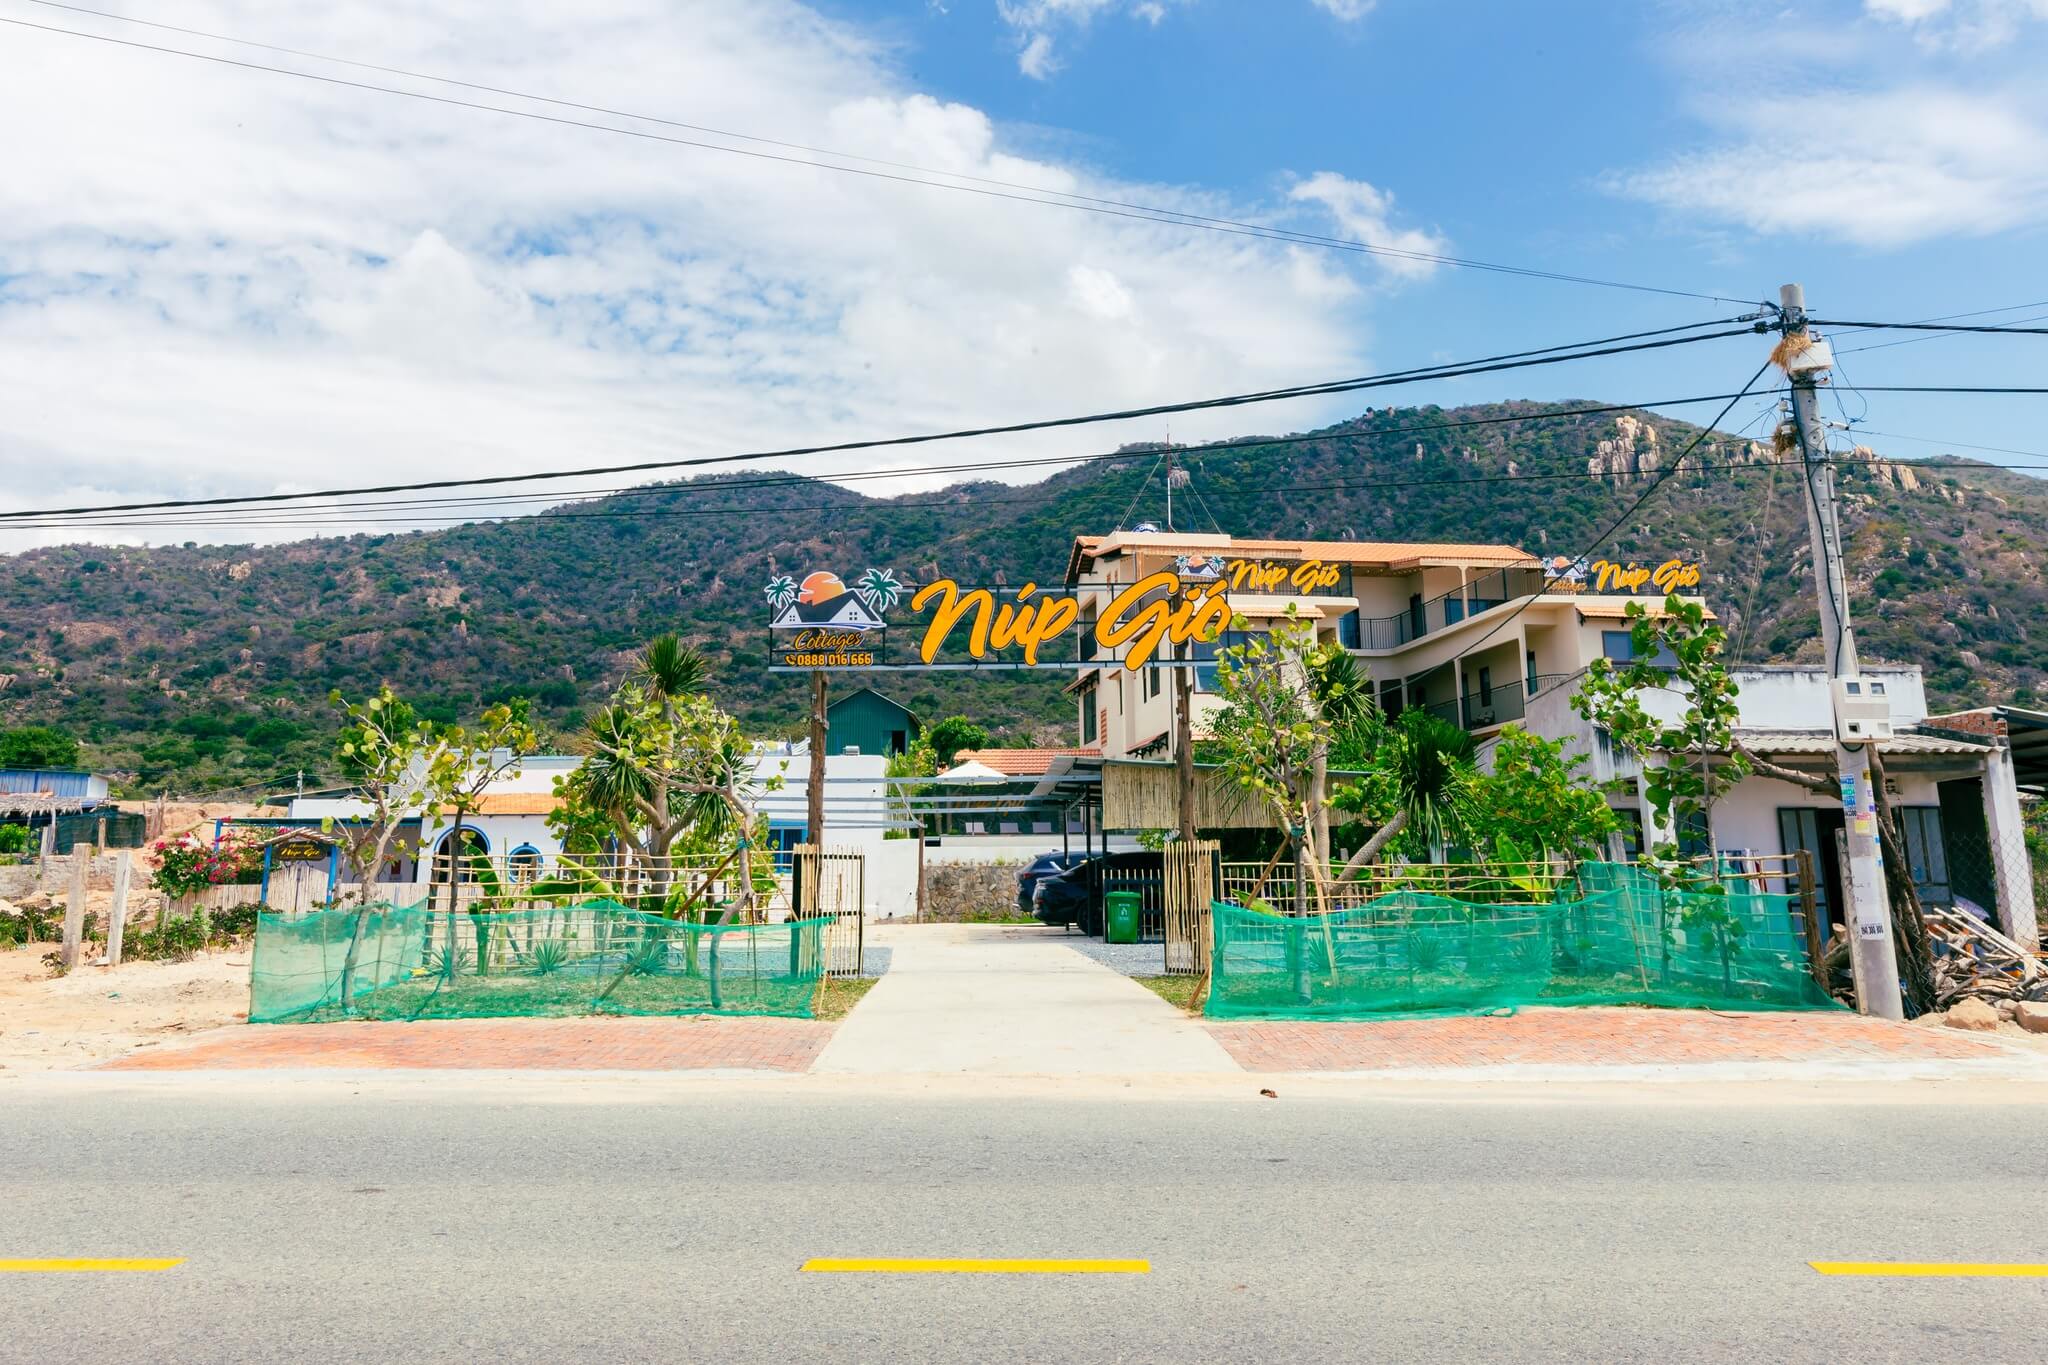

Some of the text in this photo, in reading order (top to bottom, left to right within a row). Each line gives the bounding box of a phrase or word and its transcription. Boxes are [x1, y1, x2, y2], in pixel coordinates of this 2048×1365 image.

[1227, 559, 1288, 593] Núp
[1291, 560, 1340, 595] Gió
[1591, 560, 1650, 594] Núp
[1653, 559, 1700, 594] Gió
[911, 571, 1233, 671] Núp Gió
[795, 629, 864, 654] Cottages
[797, 652, 873, 666] 0888 016 666
